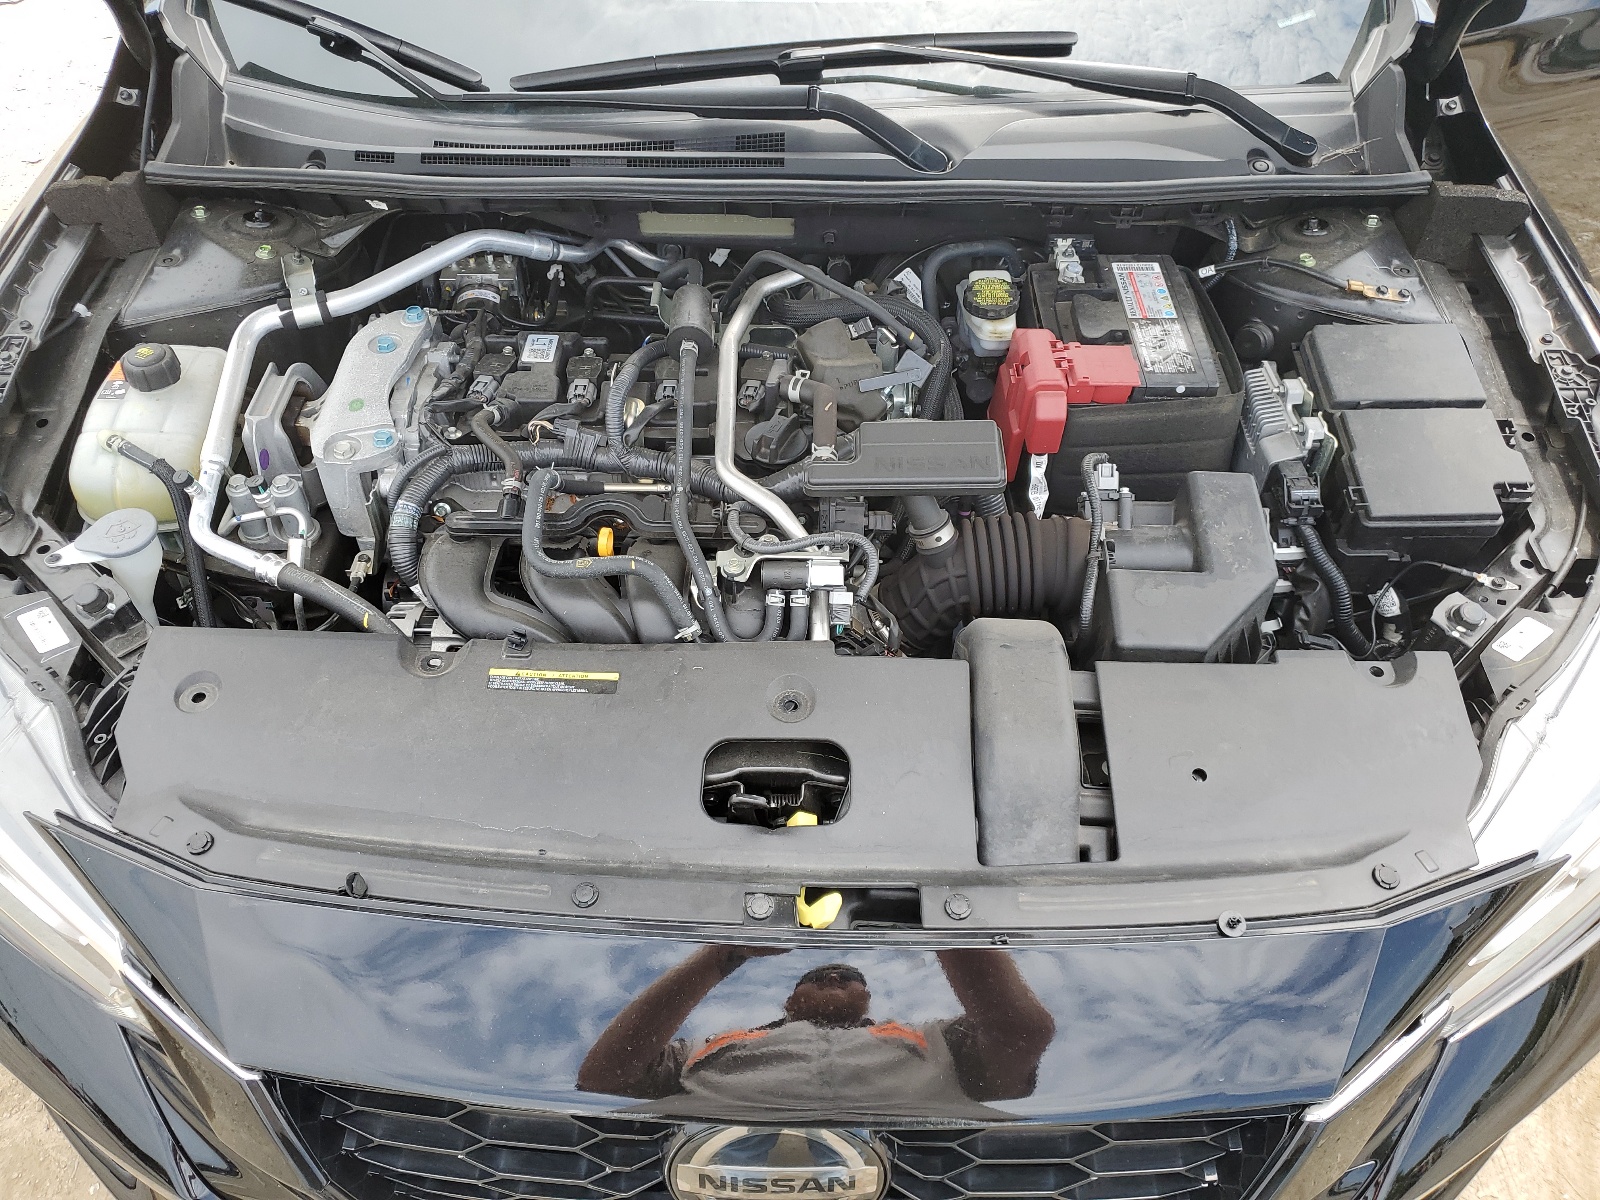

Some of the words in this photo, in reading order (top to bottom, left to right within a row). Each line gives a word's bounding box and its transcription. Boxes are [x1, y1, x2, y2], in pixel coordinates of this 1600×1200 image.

[1201, 266, 1214, 275] OA
[1119, 273, 1129, 294] NISSAN
[1126, 295, 1137, 317] RENAULT
[535, 337, 549, 345] L1
[874, 455, 992, 472] NISSAN
[698, 1173, 856, 1194] NISSAN
